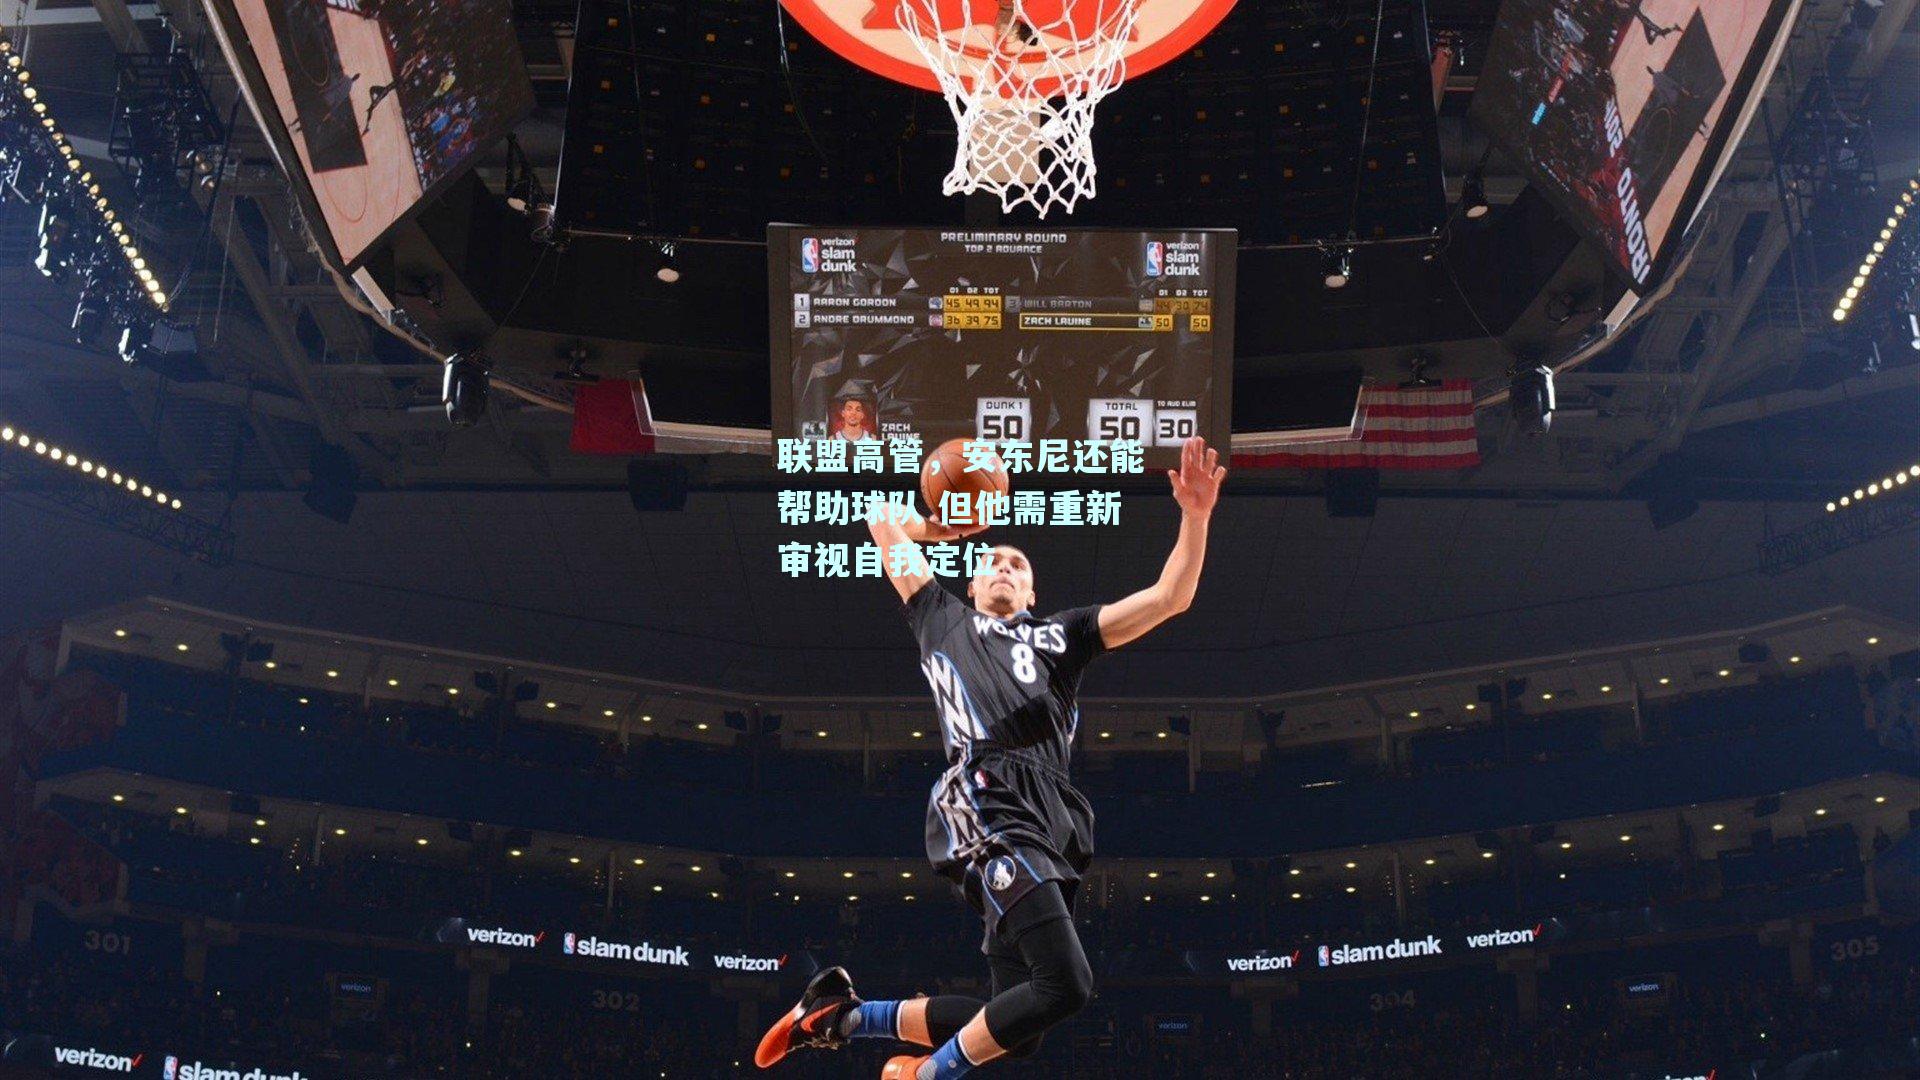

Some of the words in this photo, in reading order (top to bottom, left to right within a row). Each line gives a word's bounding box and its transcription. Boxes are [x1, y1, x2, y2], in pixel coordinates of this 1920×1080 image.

[1617, 167, 1651, 285] RONTO
[821, 237, 855, 246] verizon
[941, 232, 1022, 243] PRELIMINARY
[1025, 233, 1067, 243] ROUND
[965, 244, 984, 253] TOP
[986, 245, 994, 253] 2
[1165, 242, 1200, 250] verizon
[821, 247, 856, 259] slam
[1165, 250, 1200, 263] slam
[821, 259, 857, 272] dunk
[1165, 263, 1200, 276] dunk
[813, 298, 850, 307] AARON
[853, 298, 897, 307] GORDON
[946, 298, 960, 308] 45
[965, 298, 980, 308] 49
[983, 298, 999, 308] 94
[1024, 300, 1048, 309] WILL
[1050, 300, 1093, 309] BARTON
[798, 314, 808, 324] 2
[813, 315, 849, 324] ANDRE
[852, 315, 915, 324] DRUMMOND
[965, 316, 980, 325] 39
[984, 316, 999, 325] 75
[1024, 316, 1052, 326] ZACH
[1156, 318, 1170, 327] 50
[1193, 318, 1208, 327] 50
[986, 401, 1015, 410] DUNK
[1105, 402, 1138, 411] TOTAL
[881, 423, 911, 432] ZACH
[982, 415, 1023, 440] 50
[1100, 416, 1141, 441] 50
[1159, 418, 1193, 438] 30
[1011, 643, 1037, 683] 8
[467, 926, 537, 949] verizon
[577, 937, 631, 961] slam
[633, 941, 690, 967] dunk
[714, 953, 779, 972] verizon
[1227, 953, 1292, 972] verizon
[1331, 943, 1384, 965] slam
[1384, 935, 1442, 960] dunk
[1466, 927, 1534, 949] verizon
[1830, 935, 1880, 961] 305
[54, 1047, 132, 1073] verizon
